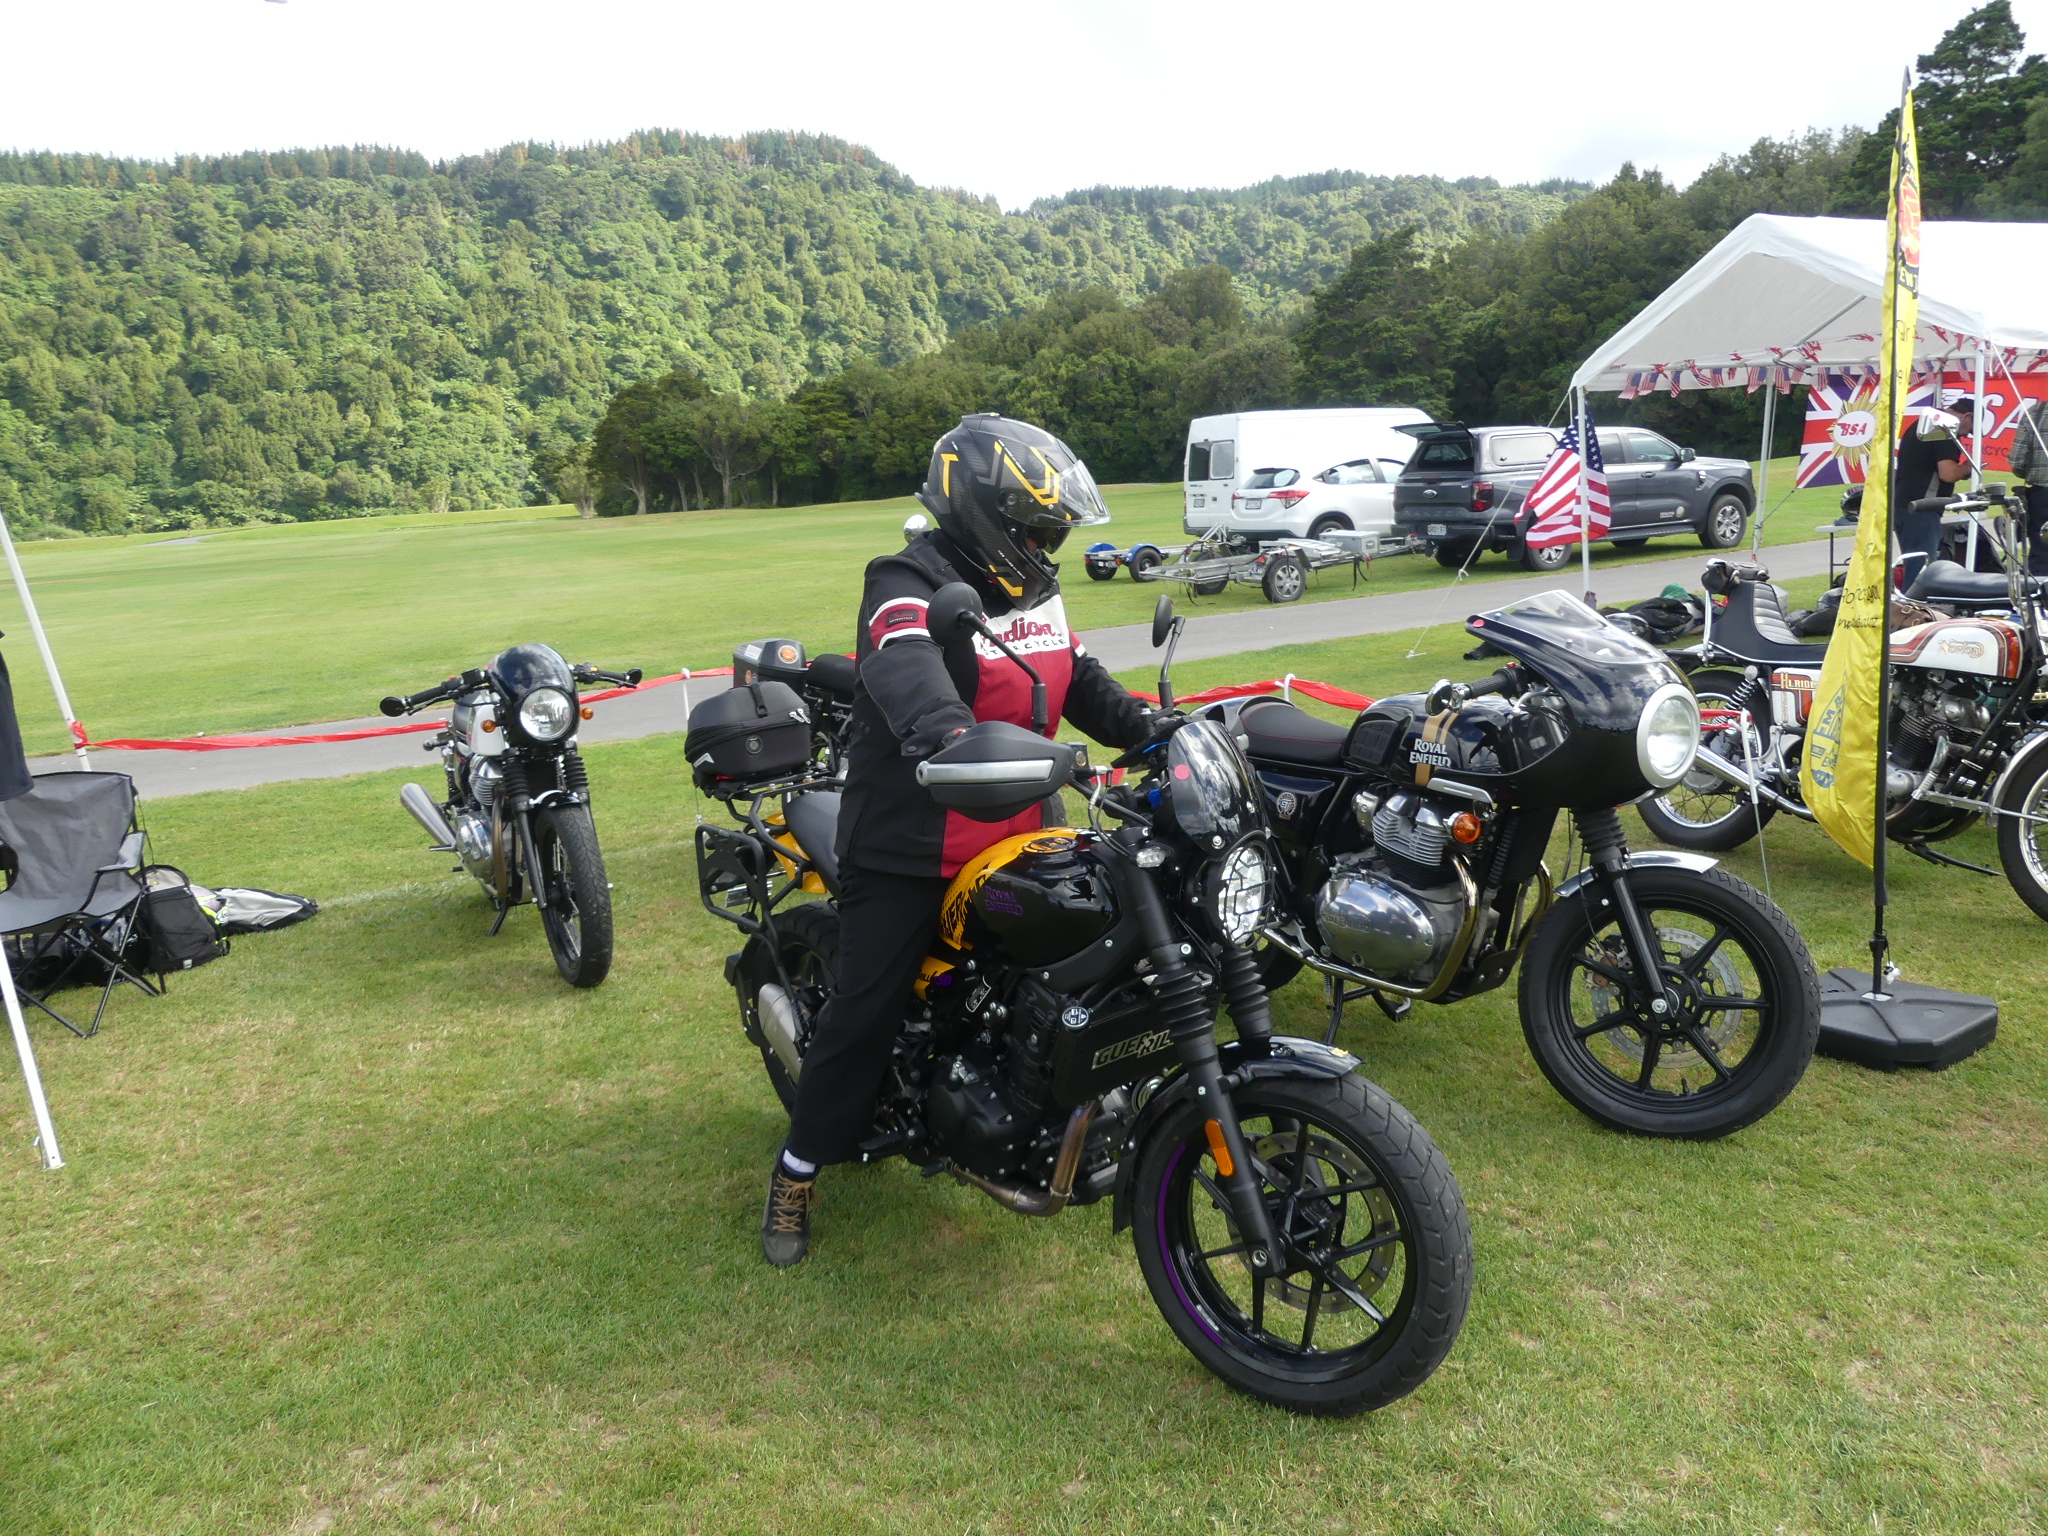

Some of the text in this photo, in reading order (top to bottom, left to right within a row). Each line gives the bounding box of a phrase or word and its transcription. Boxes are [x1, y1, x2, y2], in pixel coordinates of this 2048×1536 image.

[1837, 422, 1867, 437] BSA
[980, 616, 1056, 648] ndian
[1937, 639, 1985, 659] Norton
[1414, 738, 1448, 755] ROYAL
[1409, 751, 1452, 769] ENFIELD
[985, 886, 1018, 903] ROYAL
[985, 899, 1024, 917] ENFIELD
